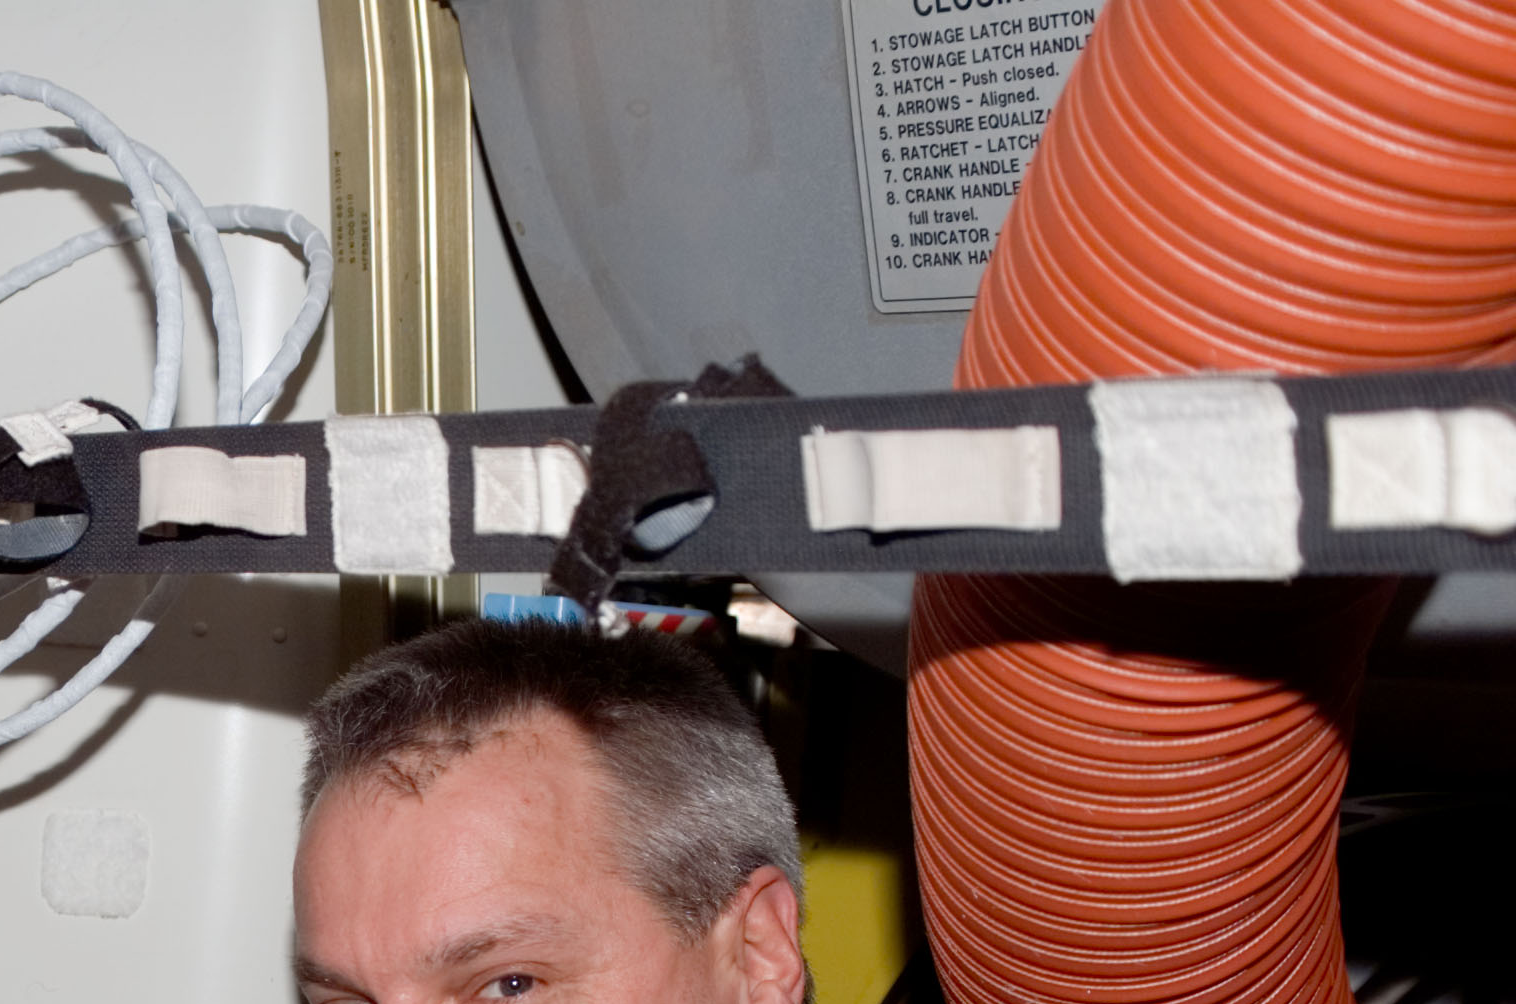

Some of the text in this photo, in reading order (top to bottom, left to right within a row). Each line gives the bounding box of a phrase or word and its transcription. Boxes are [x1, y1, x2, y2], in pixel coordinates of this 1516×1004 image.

[871, 38, 883, 53] 1.
[889, 27, 965, 51] STOWAGE
[970, 18, 1023, 40] LATCH
[1028, 8, 1095, 32] BUTTON
[872, 61, 886, 76] 2.
[891, 50, 967, 74] STOWAGE
[972, 42, 1025, 64] LATCH
[875, 83, 888, 97] 3.
[893, 75, 944, 96] HATCH
[962, 69, 997, 87] Push
[1003, 61, 1059, 82] closed.
[877, 104, 890, 118] 4.
[896, 95, 961, 117] ARROWS
[980, 87, 1039, 108] Aligned.
[879, 126, 892, 141] 5.
[898, 117, 974, 139] PRESSURE
[882, 149, 895, 163] 6.
[900, 141, 968, 161] RATCHET
[884, 169, 897, 184] 7.
[903, 164, 954, 182] CRANK
[959, 158, 1020, 178] HANDLE
[886, 191, 900, 205] 8.
[905, 186, 956, 204] CRANK
[908, 206, 979, 225] full travel.
[890, 233, 905, 248] 9.
[910, 228, 990, 247] INDICATOR
[885, 249, 992, 269] 10. CRANK HA
